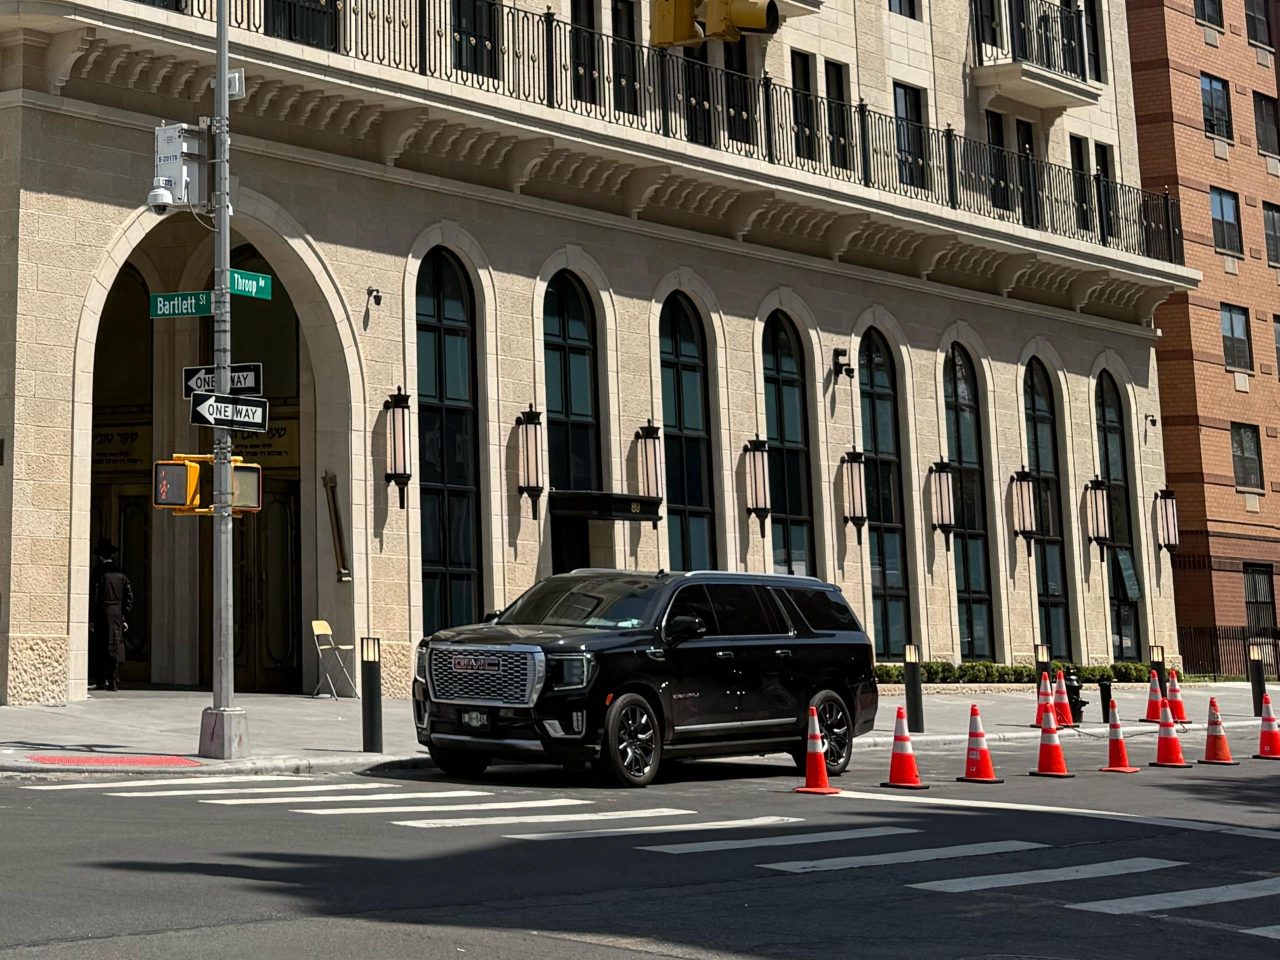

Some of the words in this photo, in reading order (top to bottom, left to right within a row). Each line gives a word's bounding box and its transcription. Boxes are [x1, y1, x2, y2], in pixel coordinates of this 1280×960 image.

[234, 273, 257, 296] Throop
[157, 297, 196, 315] Bartlett
[199, 294, 206, 305] St
[195, 376, 216, 389] ONE
[207, 404, 229, 418] ONE
[234, 407, 258, 420] WAY
[455, 658, 499, 671] GMC
